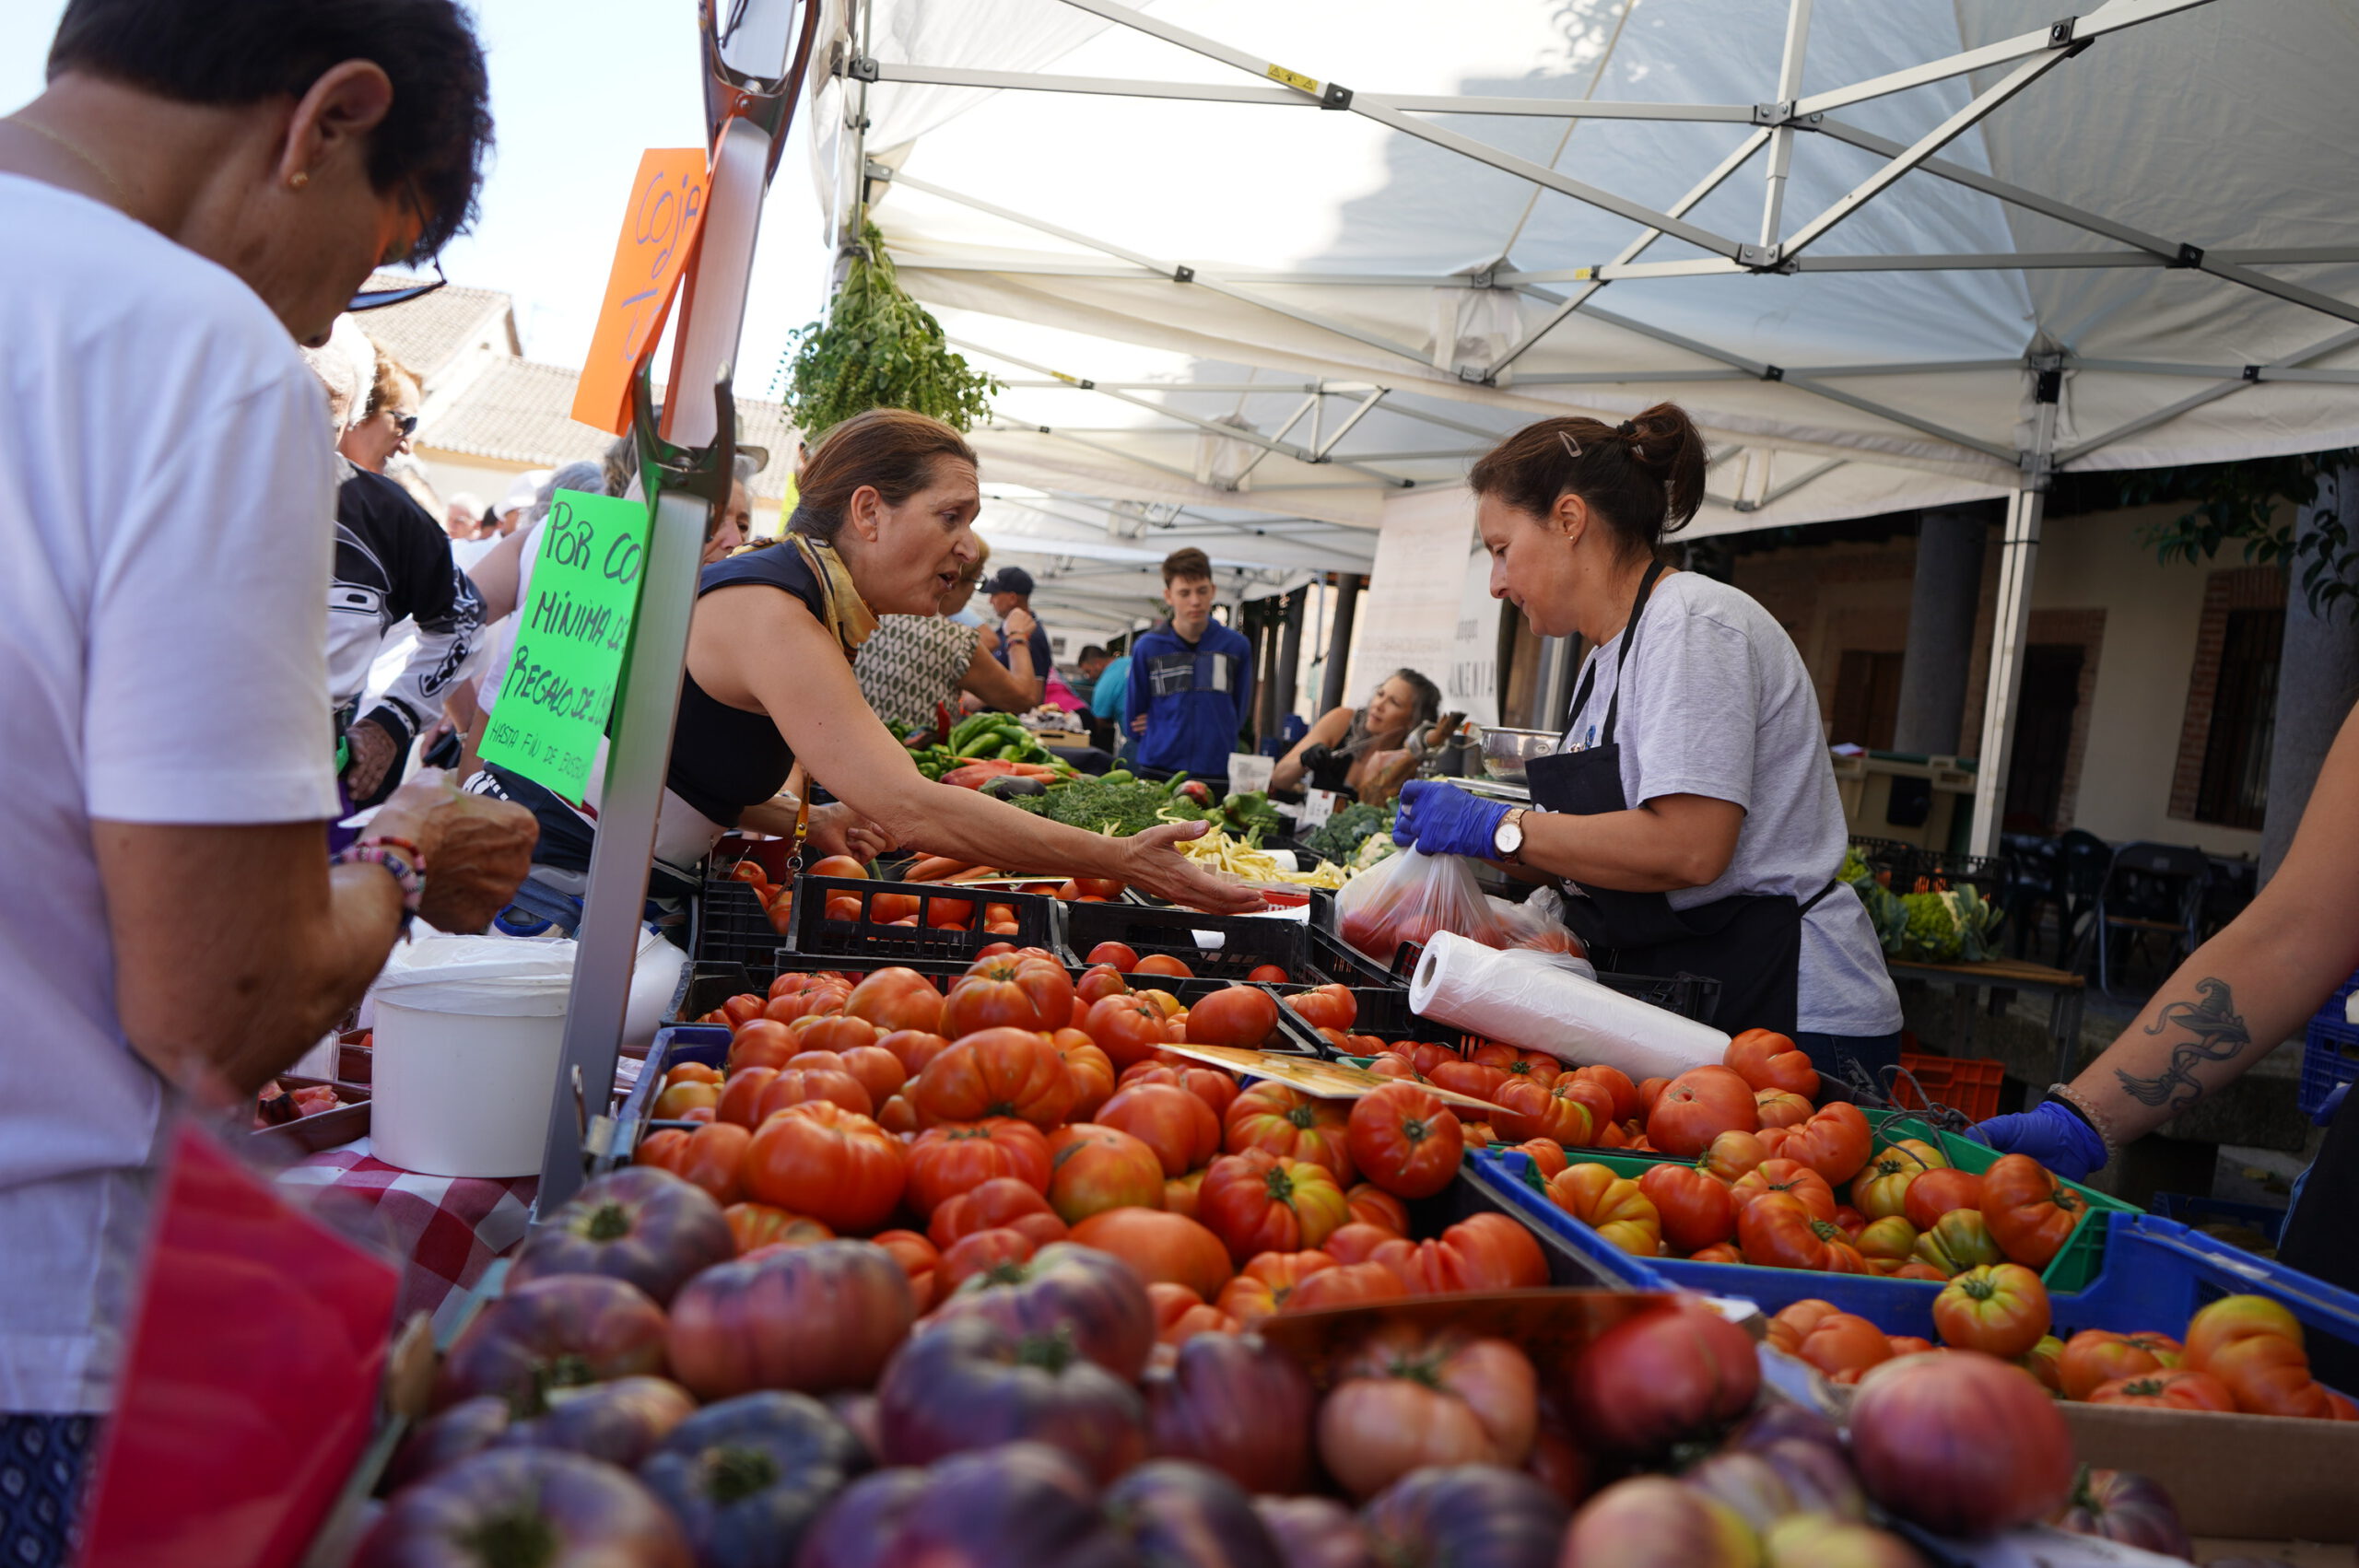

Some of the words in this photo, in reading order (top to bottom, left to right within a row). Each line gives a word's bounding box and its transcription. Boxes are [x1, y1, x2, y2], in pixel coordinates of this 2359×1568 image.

[546, 501, 594, 571] POR
[604, 532, 642, 584] CO
[503, 646, 572, 717] REGALO
[490, 720, 520, 750] HASTA
